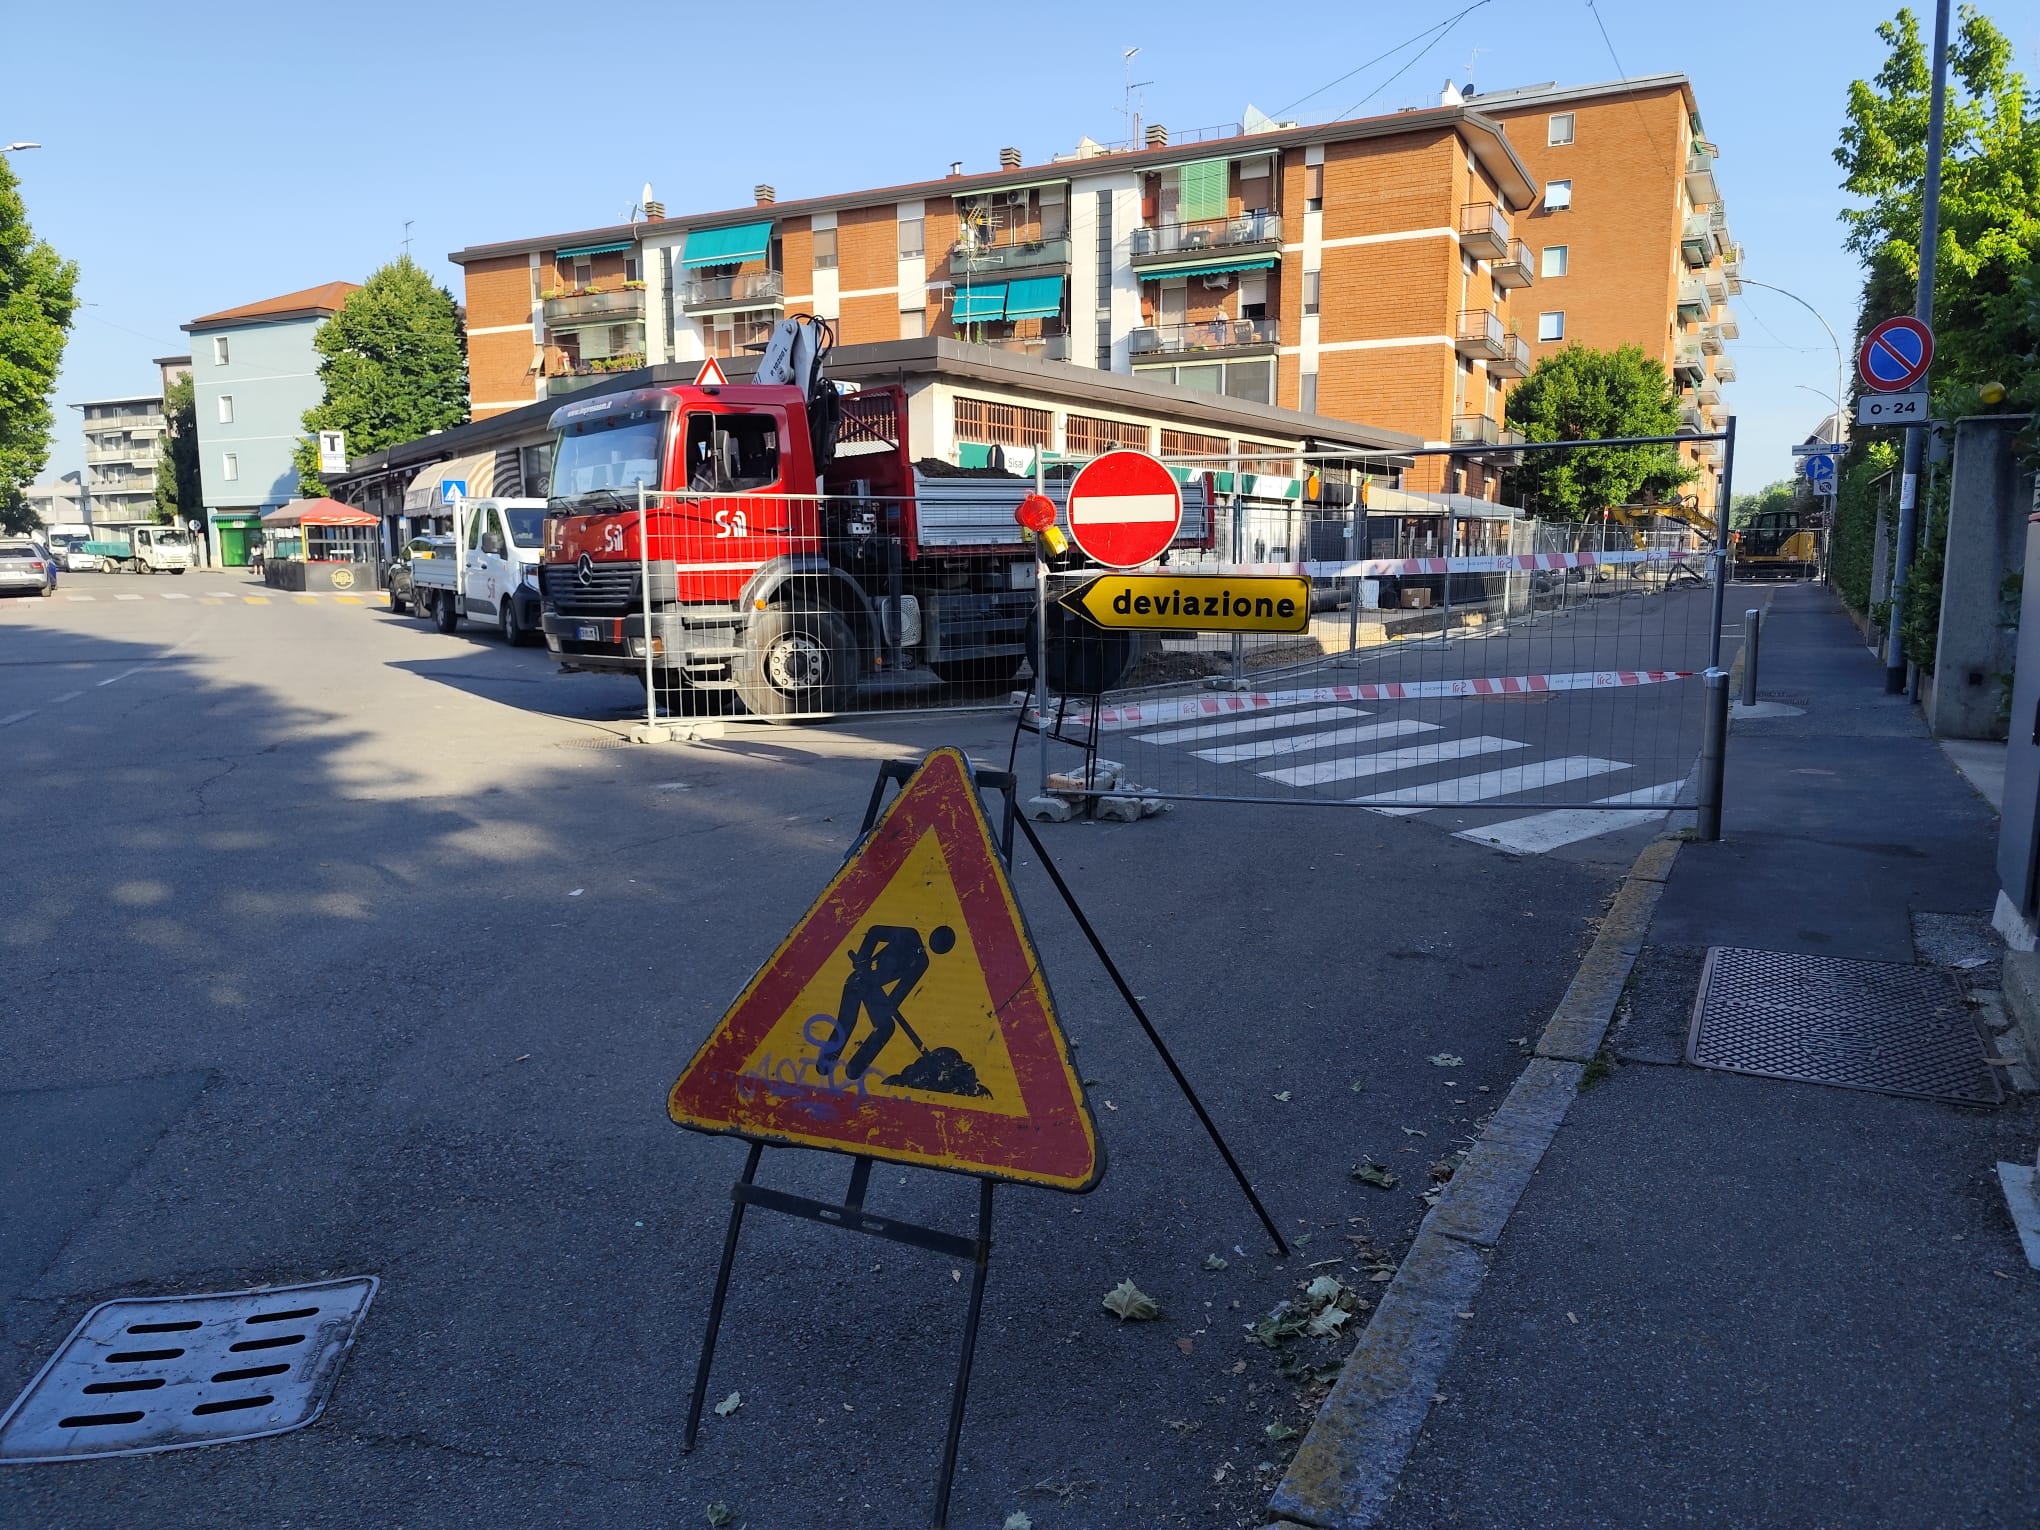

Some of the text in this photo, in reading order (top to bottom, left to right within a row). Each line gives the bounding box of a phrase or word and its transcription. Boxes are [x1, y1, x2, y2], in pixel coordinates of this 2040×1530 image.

[323, 434, 340, 451] T
[1008, 457, 1024, 469] Sisal
[1113, 589, 1295, 618] deviazione
